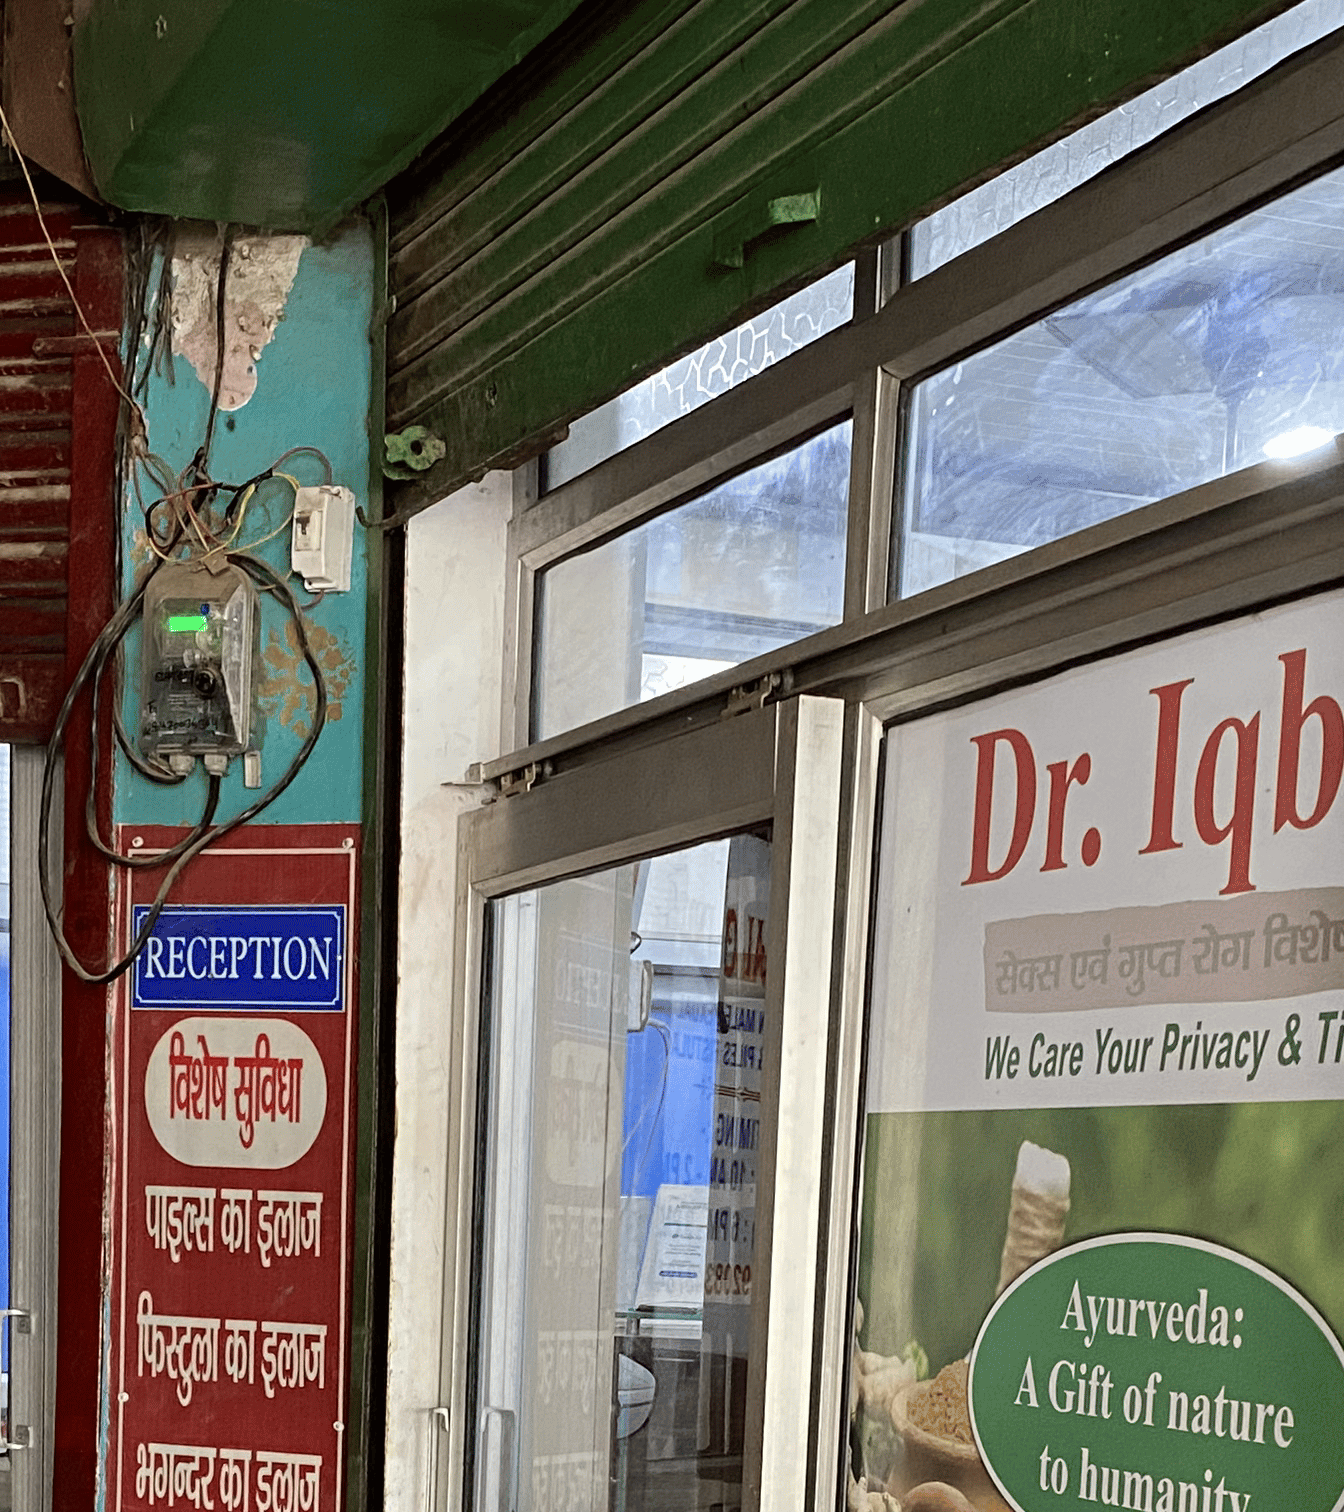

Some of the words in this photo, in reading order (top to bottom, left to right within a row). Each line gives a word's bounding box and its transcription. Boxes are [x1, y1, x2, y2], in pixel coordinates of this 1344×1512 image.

[961, 728, 1102, 886] Dr.
[145, 935, 332, 981] RECEPTION
[1069, 934, 1112, 989] एवं
[1119, 939, 1183, 996] गुप्त
[1192, 923, 1254, 975] रोग
[985, 1035, 1020, 1081] We
[1028, 1031, 1083, 1078] Care
[1095, 1027, 1152, 1076] Your
[1160, 1022, 1269, 1082] Privacy
[1279, 1013, 1301, 1065] &
[169, 1031, 228, 1121] विशेष
[234, 1033, 303, 1149] सुविधा
[145, 1185, 216, 1264] पाइल्स
[221, 1189, 253, 1254] का
[257, 1190, 323, 1267] इलाज
[136, 1290, 220, 1406] फिस्टुला
[225, 1319, 257, 1385] का
[260, 1321, 327, 1398] इलाज
[1060, 1278, 1243, 1348] Ayurveda:
[1014, 1356, 1039, 1408] A
[1048, 1360, 1112, 1419] Gift
[1123, 1372, 1162, 1427] of
[1167, 1385, 1294, 1448] nature
[136, 1442, 217, 1510] भगन्दर
[219, 1448, 252, 1512] का
[1039, 1444, 1068, 1494] to
